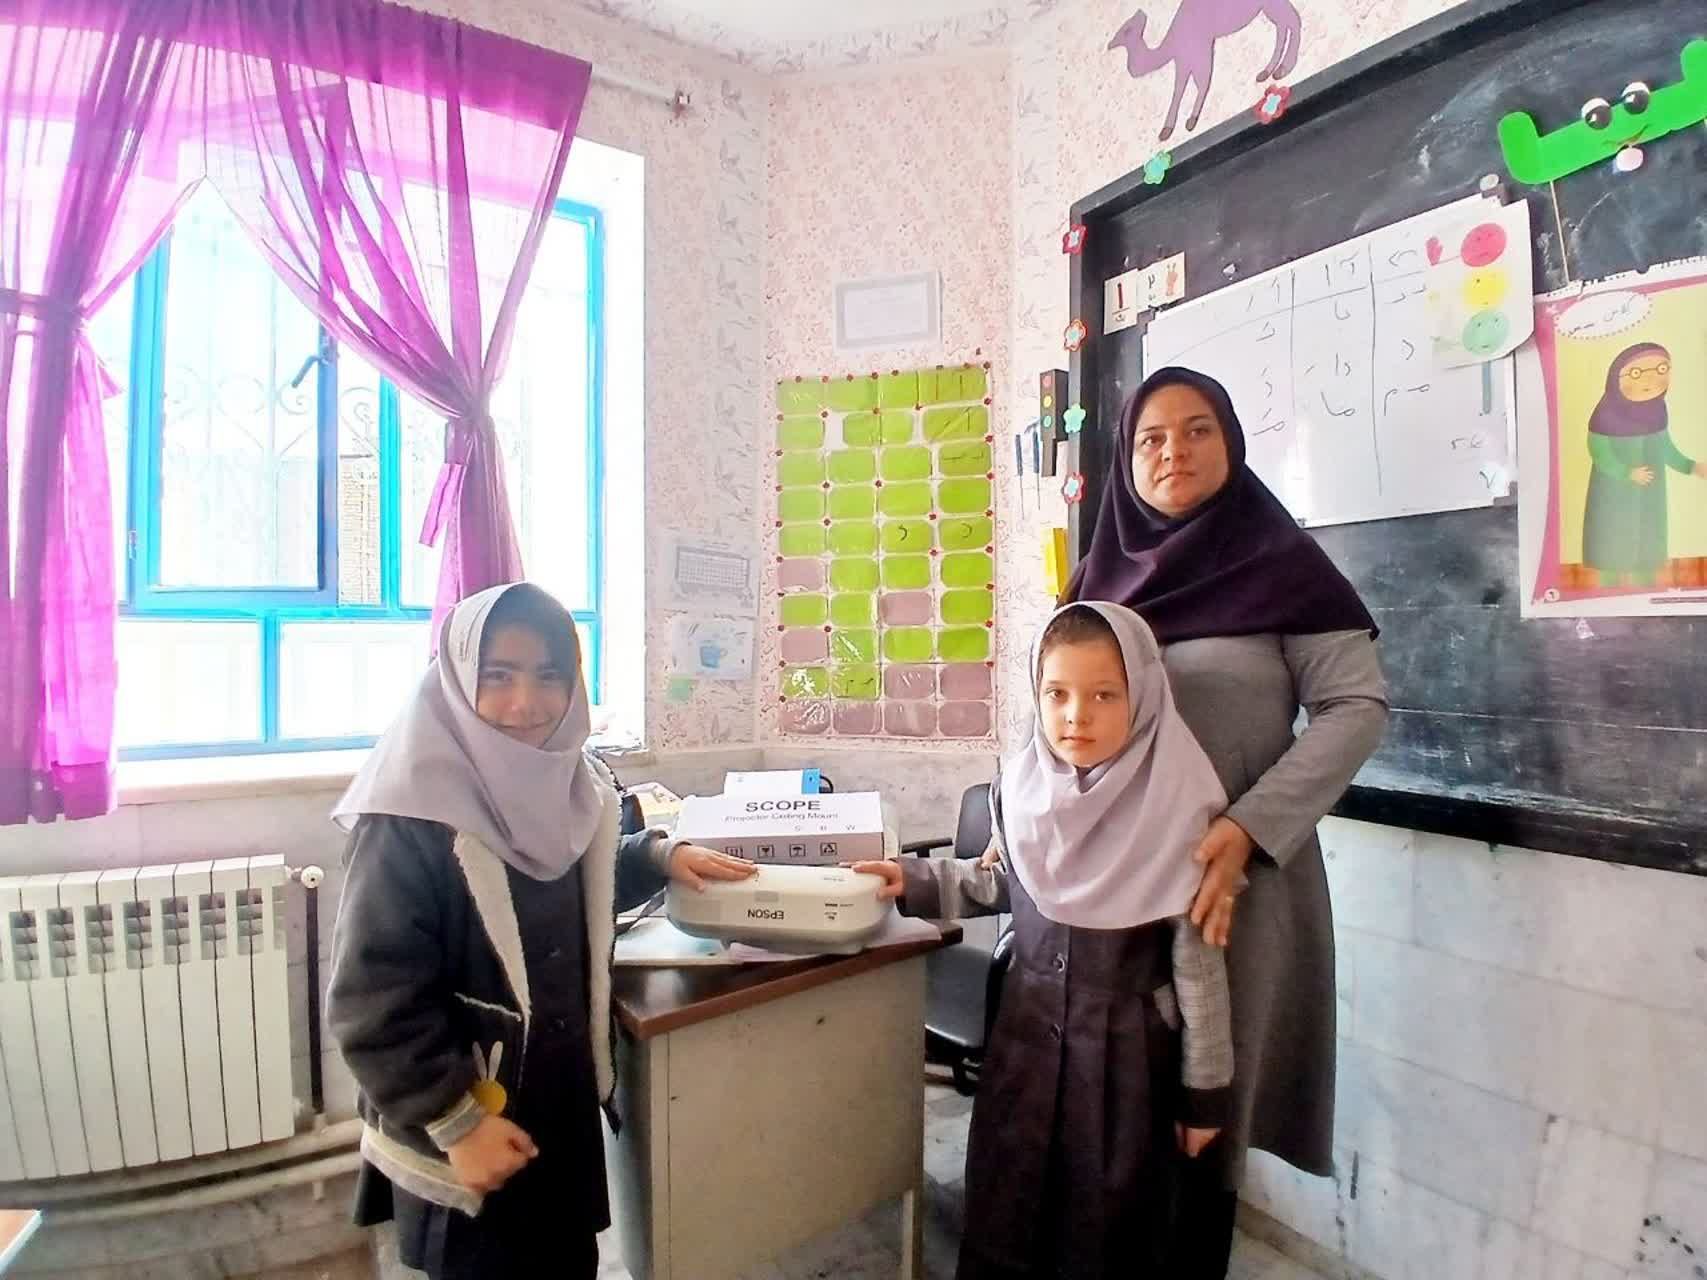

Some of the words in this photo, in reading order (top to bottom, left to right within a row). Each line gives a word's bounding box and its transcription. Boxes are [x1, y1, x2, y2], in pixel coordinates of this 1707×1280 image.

[745, 800, 821, 812] SCOPE
[807, 811, 838, 820] Mount
[747, 908, 785, 920] EPSON
